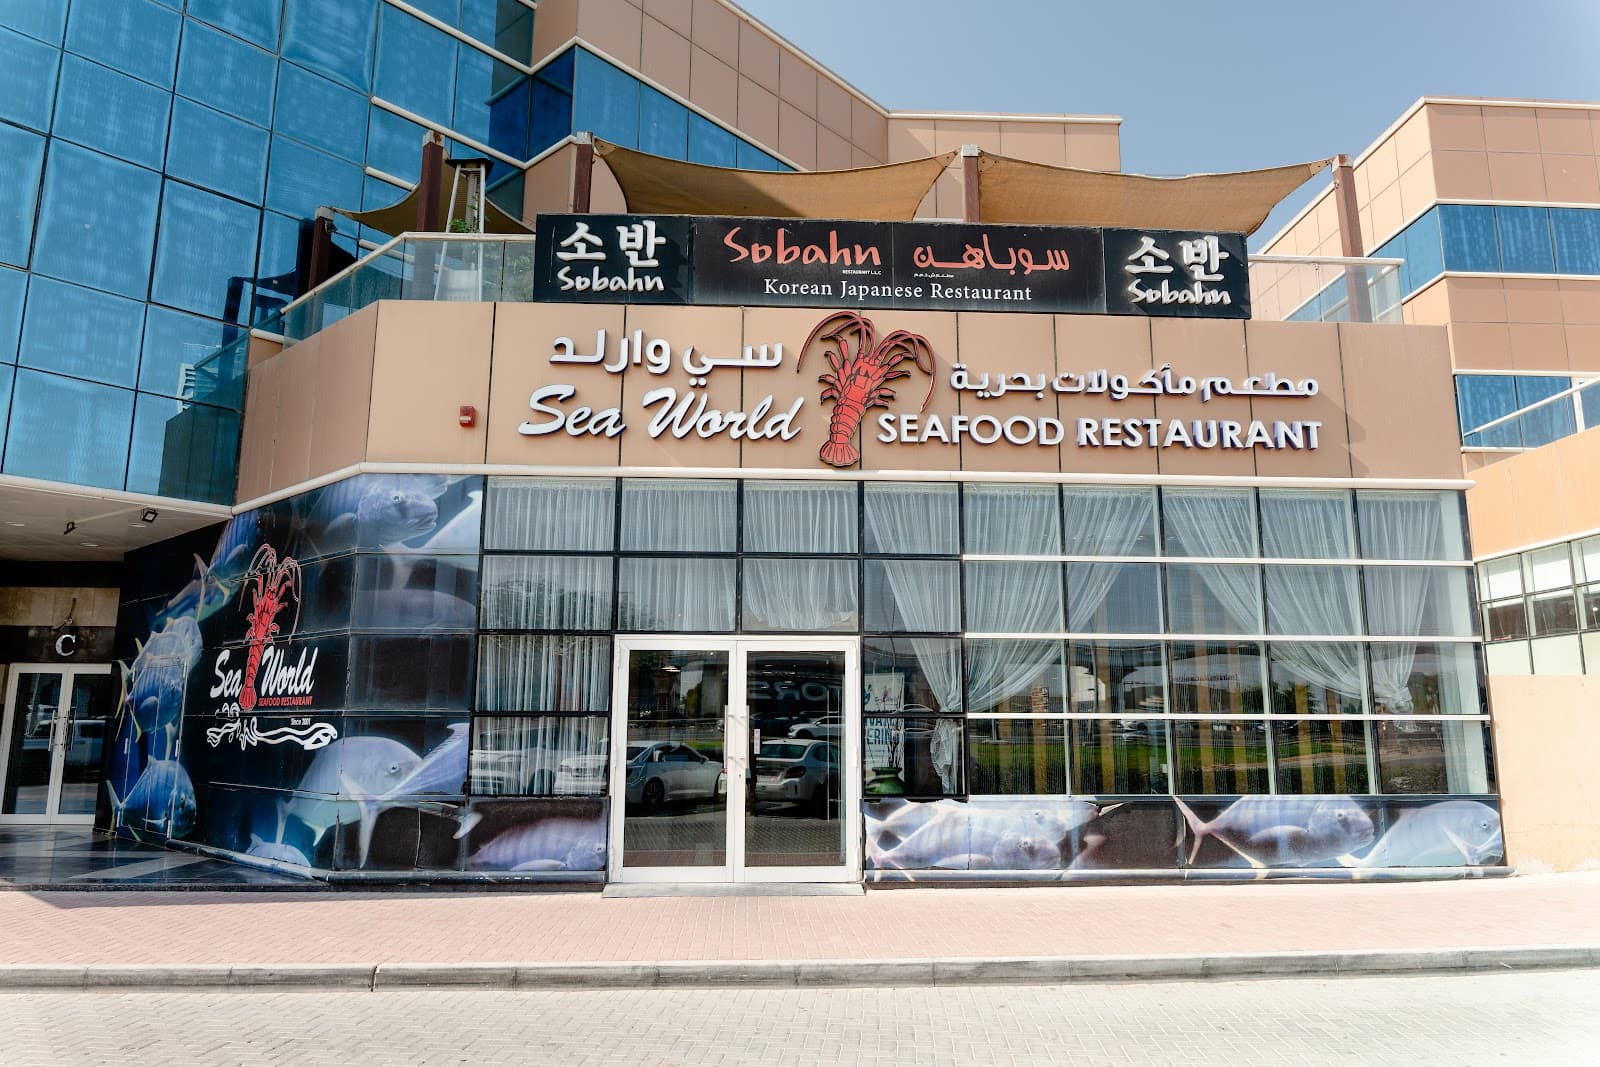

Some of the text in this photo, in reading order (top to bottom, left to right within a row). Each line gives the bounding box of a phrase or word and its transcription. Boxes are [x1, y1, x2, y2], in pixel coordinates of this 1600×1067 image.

[723, 226, 882, 266] Sobahn
[913, 233, 1070, 276] سوباهن
[557, 266, 664, 291] Sobahn
[763, 278, 1033, 301] Korean Japanese Restaurant
[1127, 279, 1232, 305] Sobahn
[549, 328, 784, 388] سي وارلد
[950, 362, 1319, 403] مطعم مأكولات بحرية
[517, 384, 805, 442] Sea World
[877, 413, 1323, 449] SEAFOOD RESTAURANT
[55, 634, 77, 657] C
[209, 645, 319, 698] Sea World
[258, 695, 313, 707] SEAFOOD RESTAURANT
